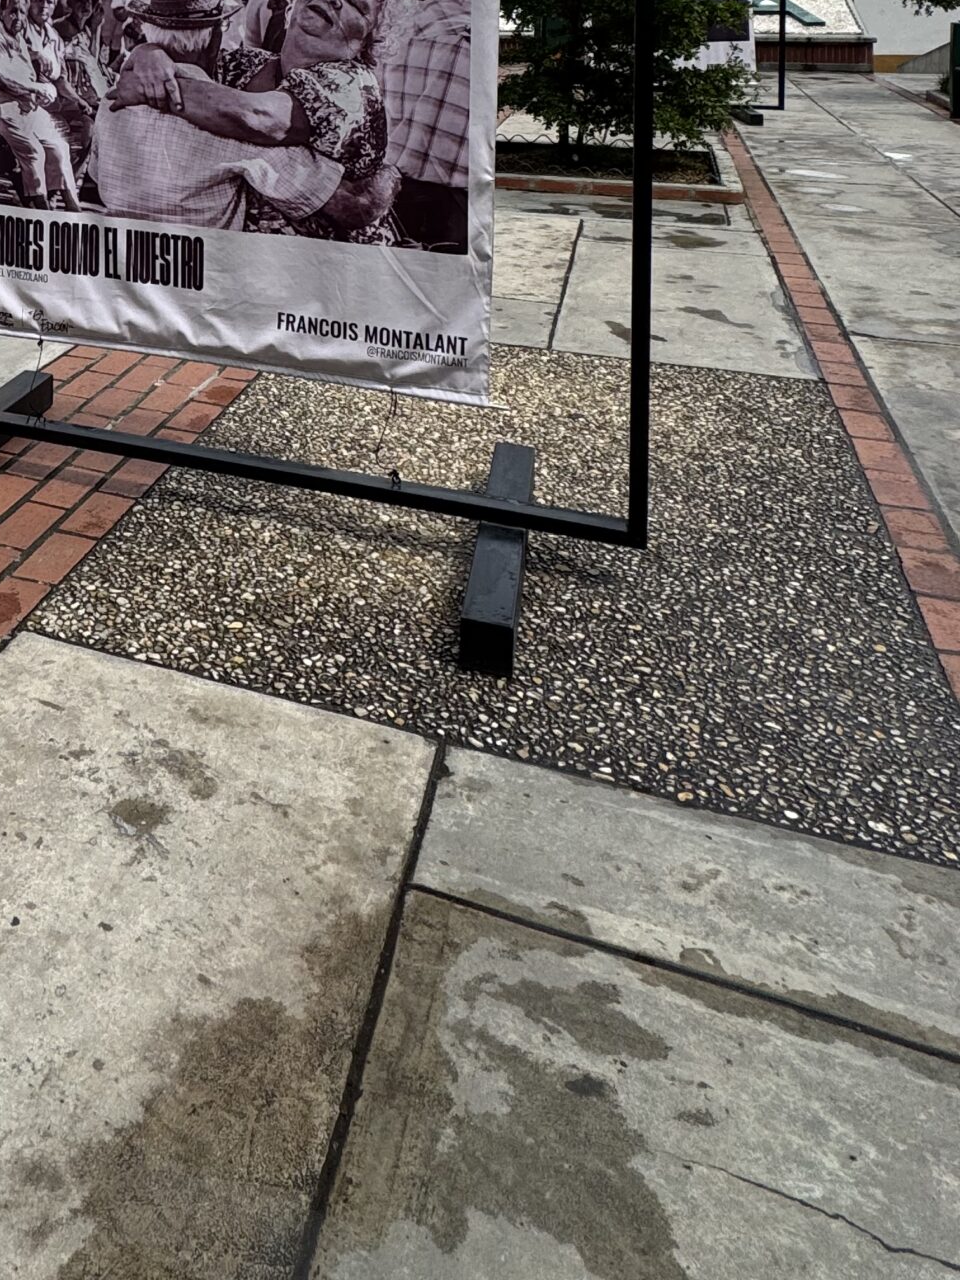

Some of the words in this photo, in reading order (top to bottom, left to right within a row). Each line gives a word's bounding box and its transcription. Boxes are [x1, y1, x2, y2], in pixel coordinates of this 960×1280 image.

[48, 220, 100, 277] COMO
[104, 226, 121, 280] EL
[126, 229, 204, 291] NUESTRO
[6, 269, 49, 283] VENEZOLANO
[276, 312, 359, 341] FRANCOIS
[364, 324, 469, 356] MONTALANT
[366, 346, 469, 368] @FRANCOISMONTALANT
